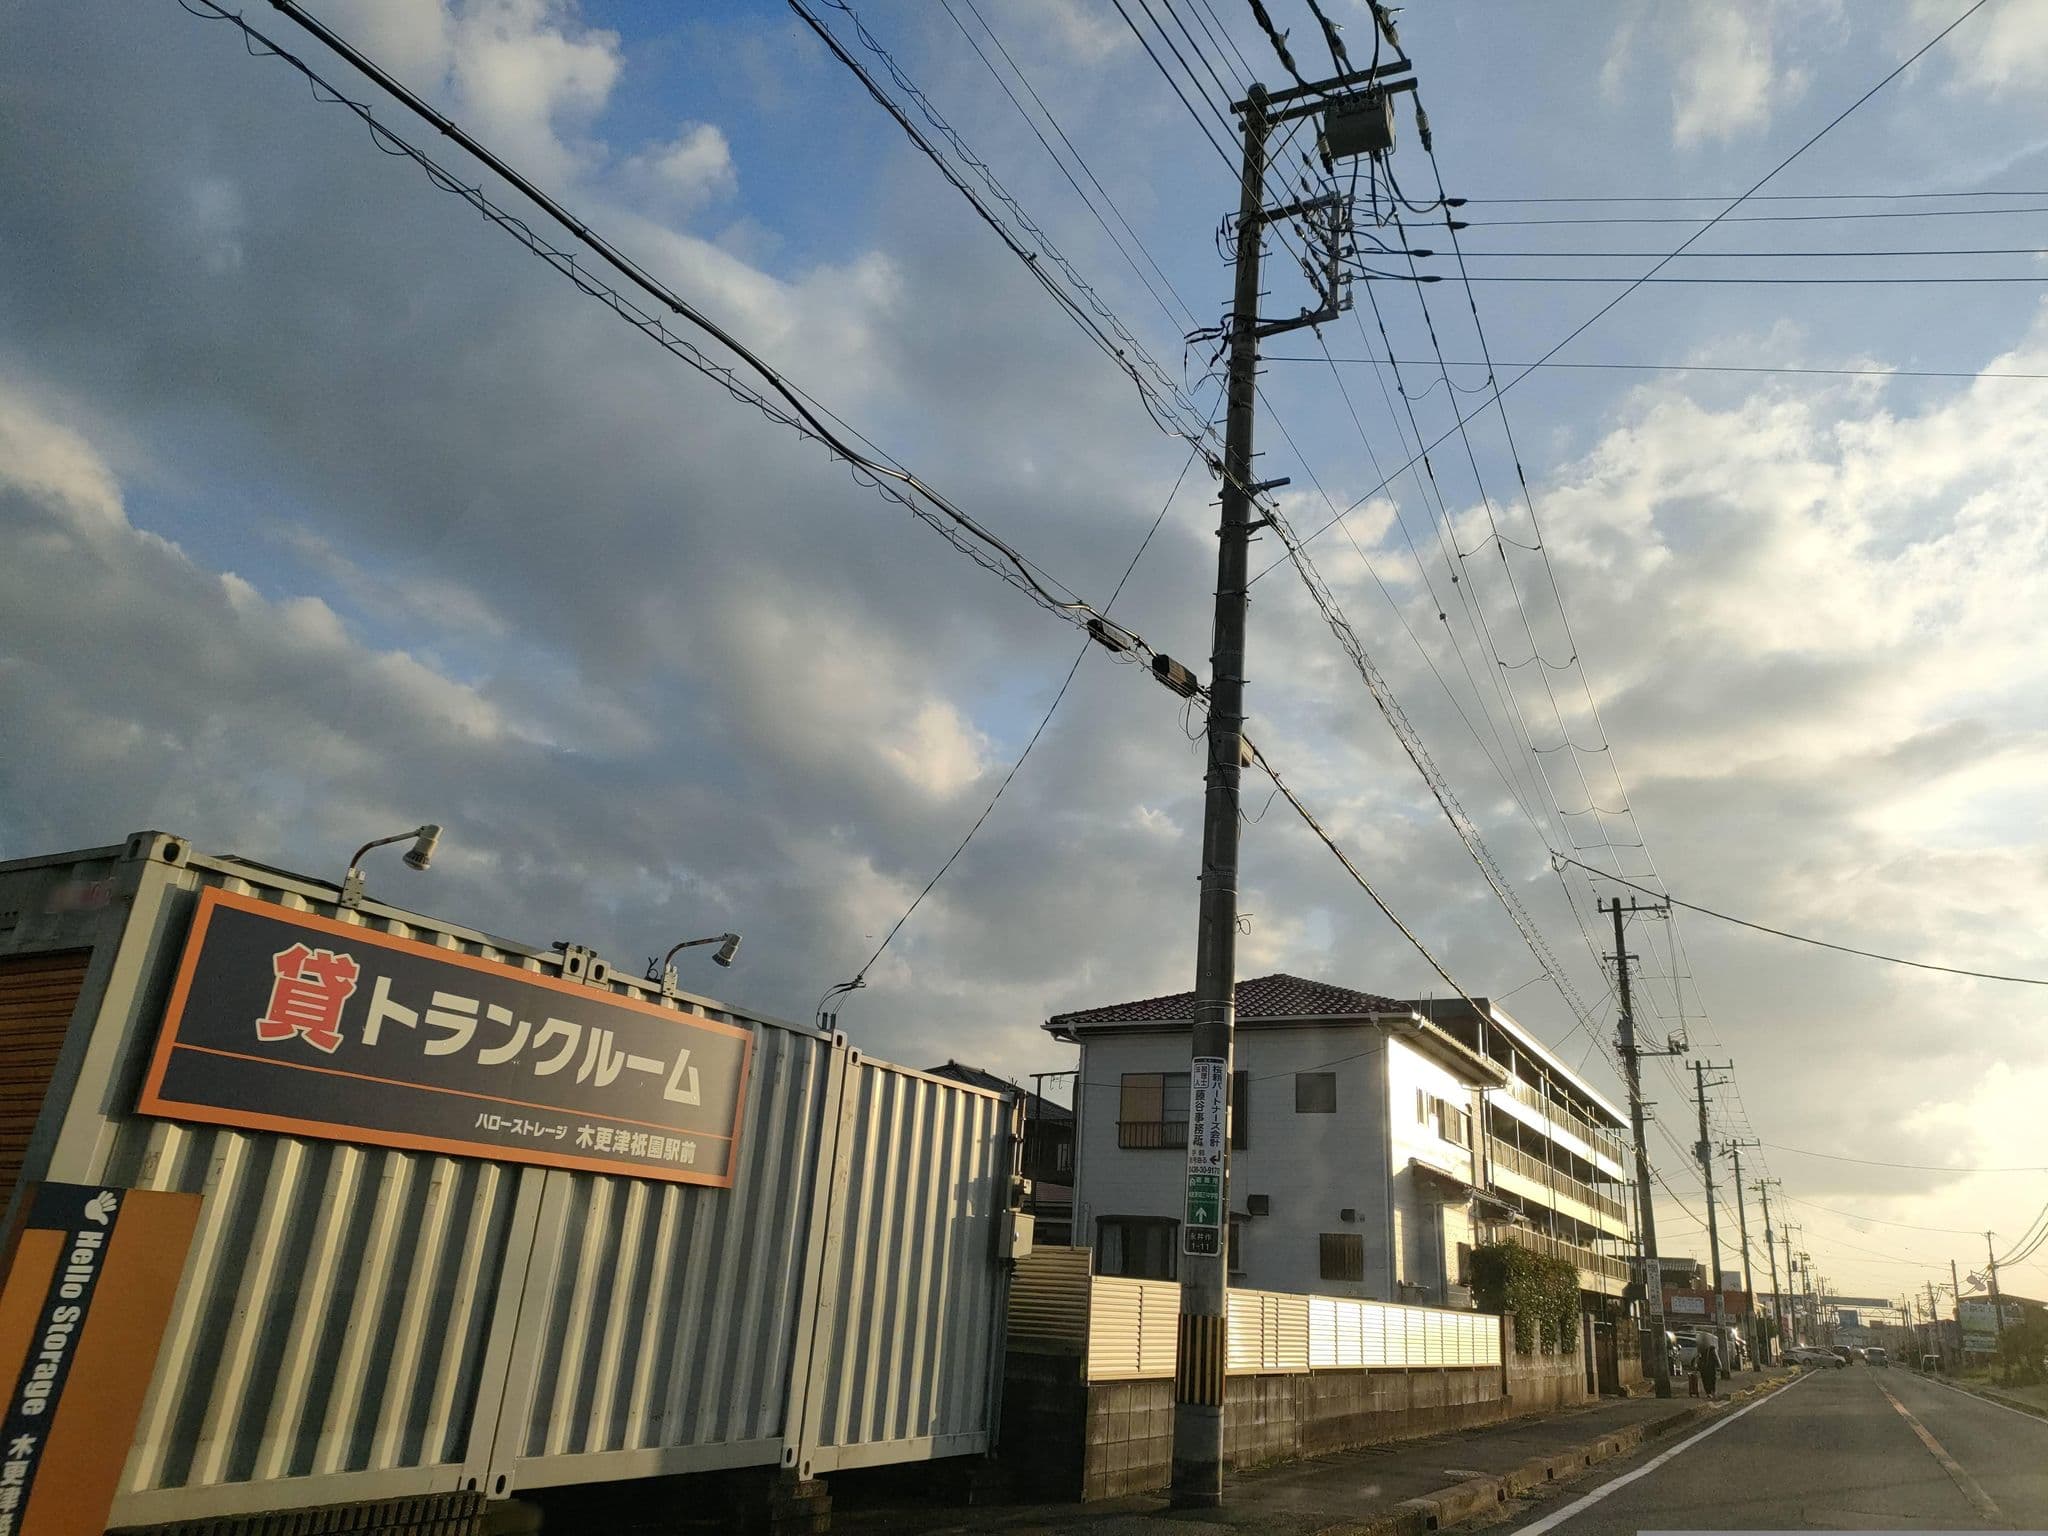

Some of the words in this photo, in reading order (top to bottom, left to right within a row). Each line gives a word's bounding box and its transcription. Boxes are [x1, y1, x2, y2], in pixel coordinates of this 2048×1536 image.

[255, 942, 701, 1106] 貸トランクルーム
[475, 1112, 569, 1140] ハローストレージ
[60, 1230, 104, 1299] Hello
[21, 1306, 82, 1416] Storage
